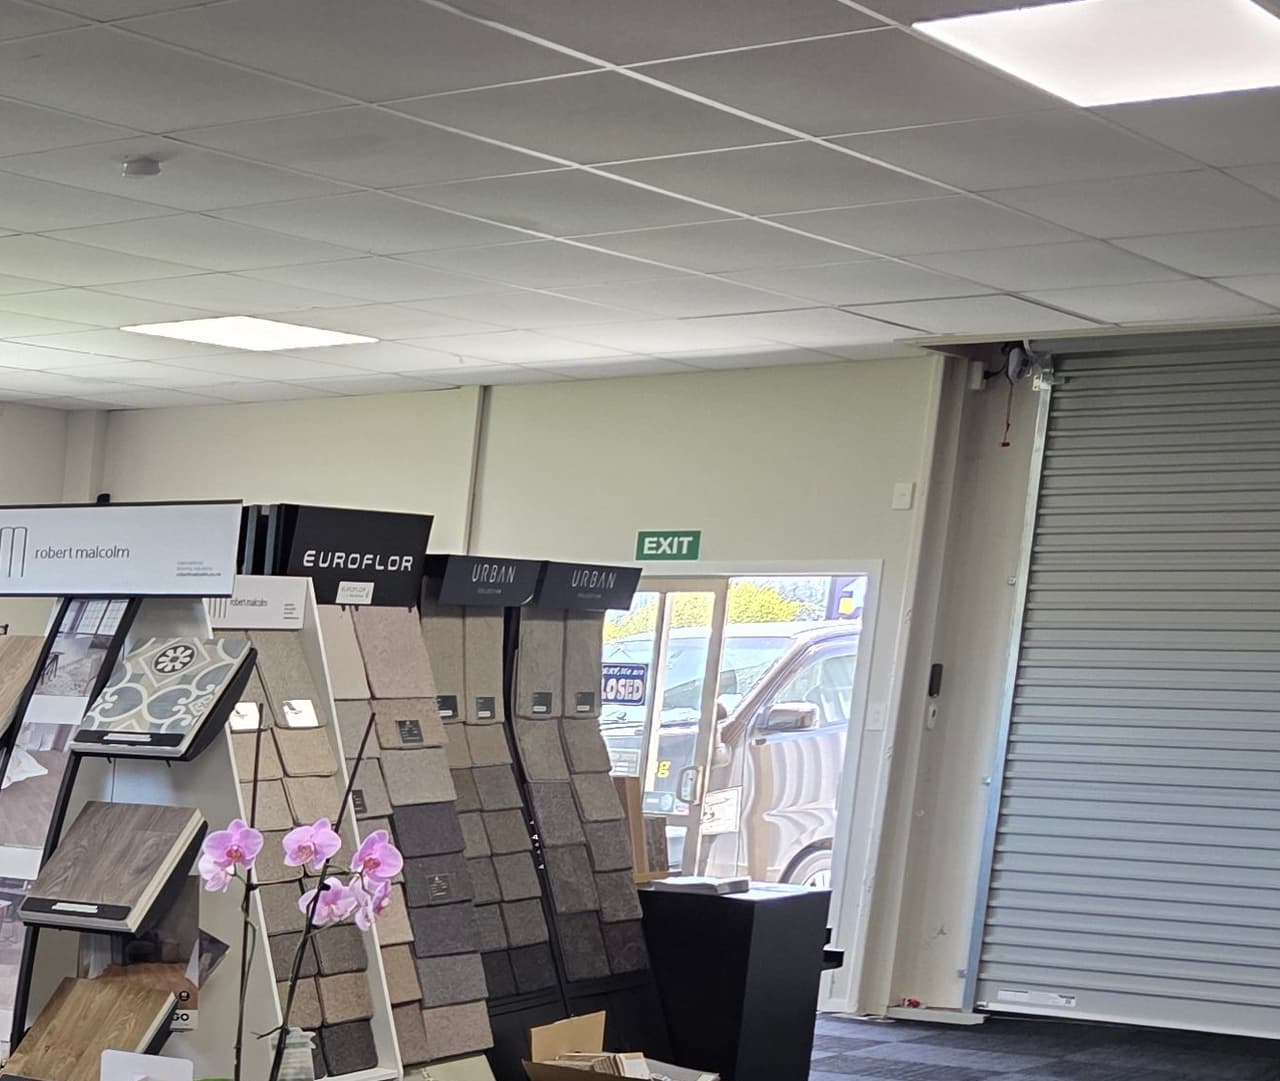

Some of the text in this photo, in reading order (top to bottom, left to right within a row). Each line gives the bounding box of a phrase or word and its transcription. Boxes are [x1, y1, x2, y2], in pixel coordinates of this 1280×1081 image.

[34, 545, 130, 559] robert malcolm
[643, 536, 694, 554] EXIT
[303, 550, 414, 572] EUROFLOR
[472, 563, 516, 584] URBAN
[572, 569, 617, 588] URBAN
[601, 678, 643, 700] LOSED
